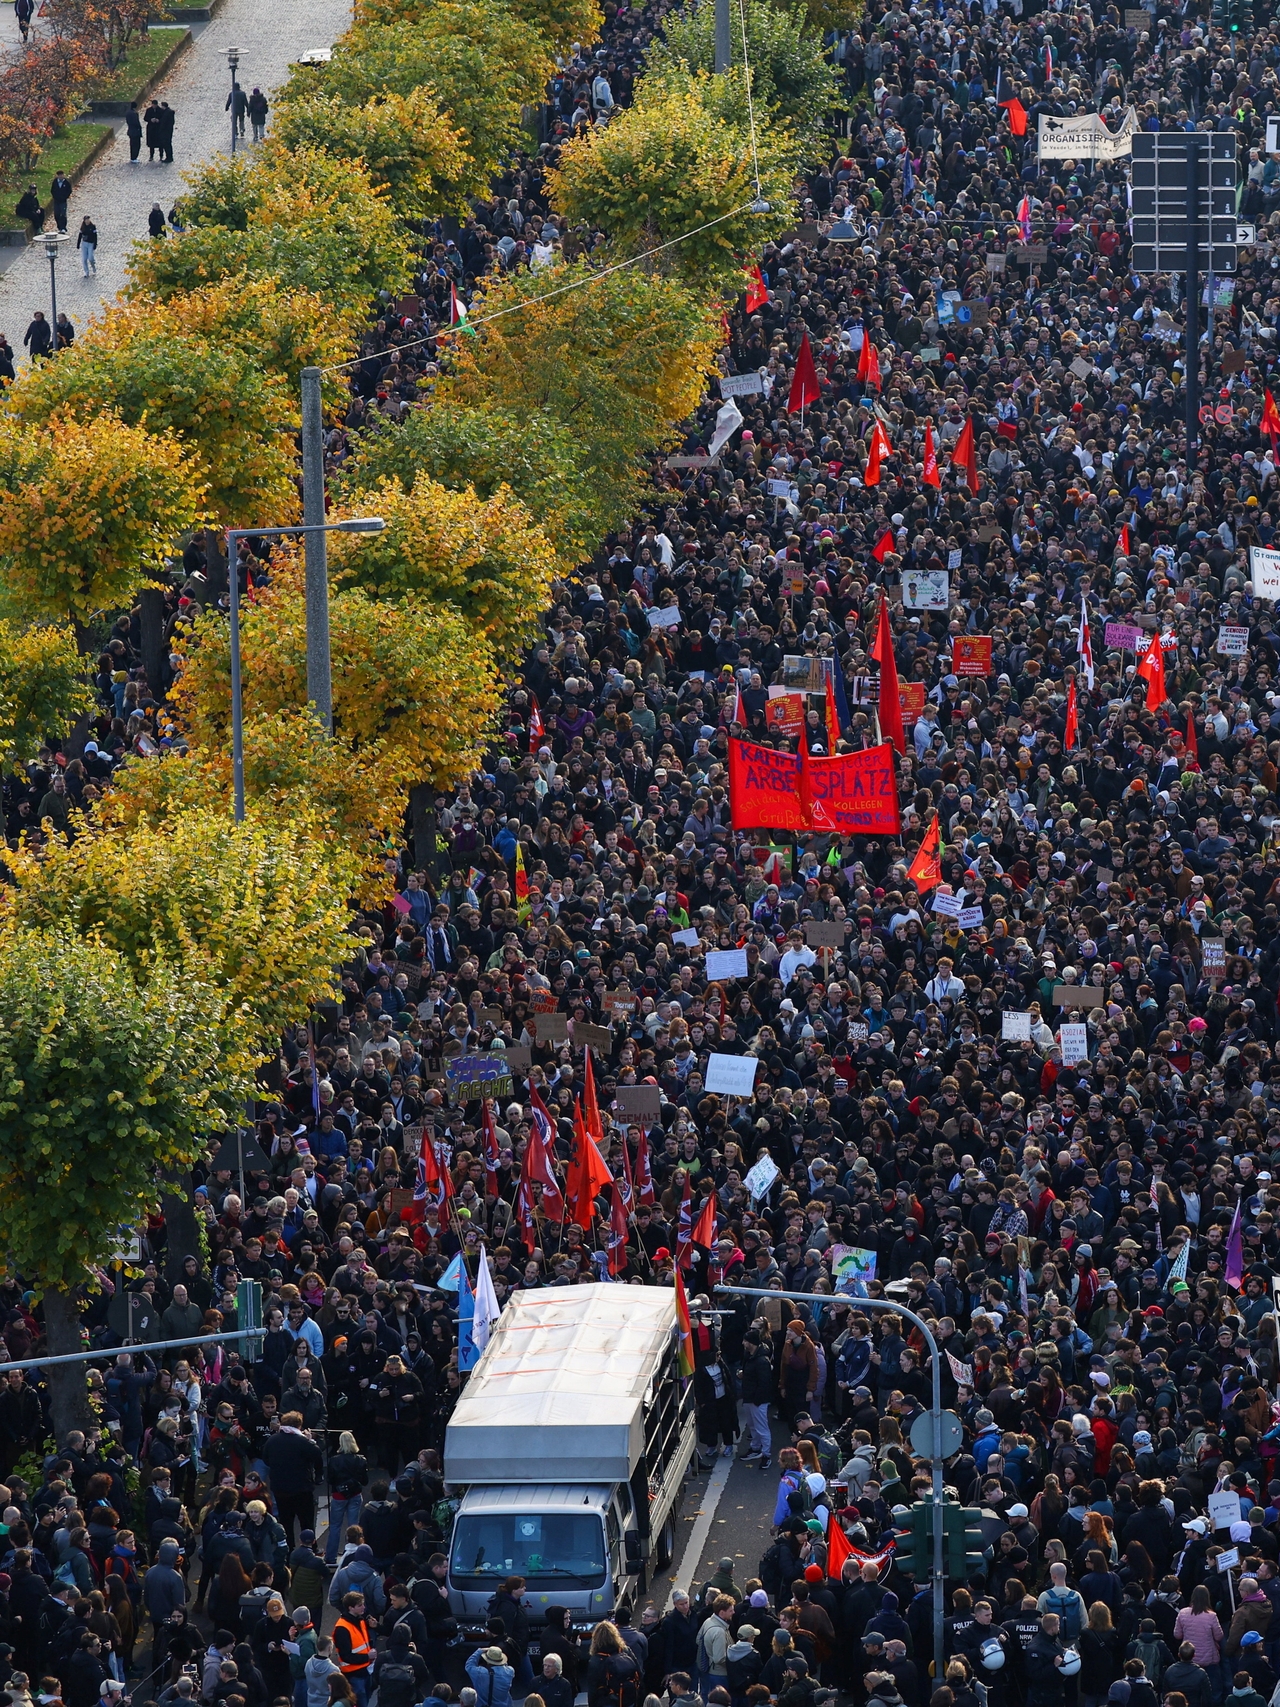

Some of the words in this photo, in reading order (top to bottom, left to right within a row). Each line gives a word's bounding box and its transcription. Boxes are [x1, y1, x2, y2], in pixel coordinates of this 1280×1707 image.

[1042, 133, 1107, 144] ORGANISIERT
[722, 384, 735, 395] NOT
[736, 382, 757, 392] PEOPLE
[1106, 633, 1136, 642] SOLIDARISC
[1106, 640, 1135, 649] HOCHSCHU
[840, 754, 884, 771] jeden
[745, 765, 893, 800] ARBESPLATZ
[834, 800, 883, 811] KOLLEGEN
[836, 812, 873, 825] FORD
[614, 1001, 635, 1010] TOGETHER
[1003, 1012, 1019, 1020] LESS
[1061, 1028, 1086, 1036] ASOZIAL
[458, 1074, 512, 1100] RECHT
[618, 1112, 660, 1124] GEWALT
[1015, 1624, 1039, 1632] POLIZEI
